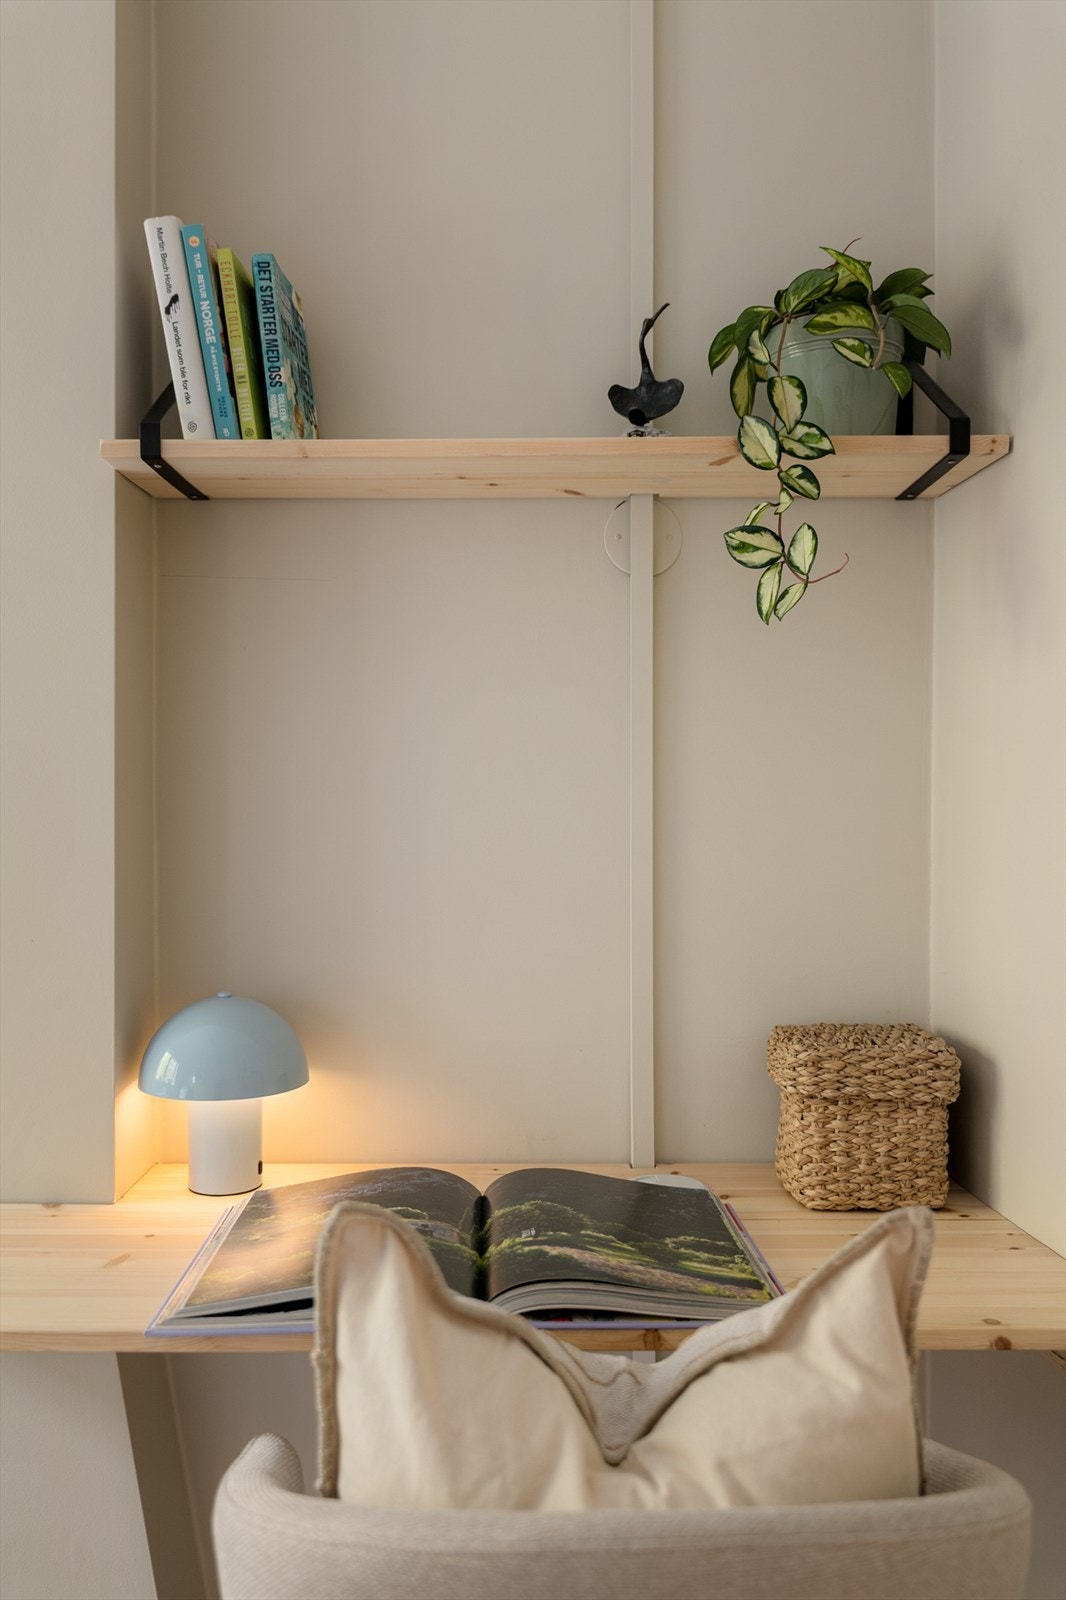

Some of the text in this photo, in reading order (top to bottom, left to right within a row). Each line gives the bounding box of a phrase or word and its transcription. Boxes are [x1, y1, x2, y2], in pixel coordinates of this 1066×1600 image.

[156, 227, 172, 294] Martin Bech Holte
[194, 252, 202, 268] TUR
[197, 274, 208, 299] RETUR
[220, 261, 240, 340] ECKHART TOLLE
[172, 321, 182, 348] Landet
[200, 300, 216, 344] NORGE
[256, 262, 282, 388] DET STARTER MED OSS
